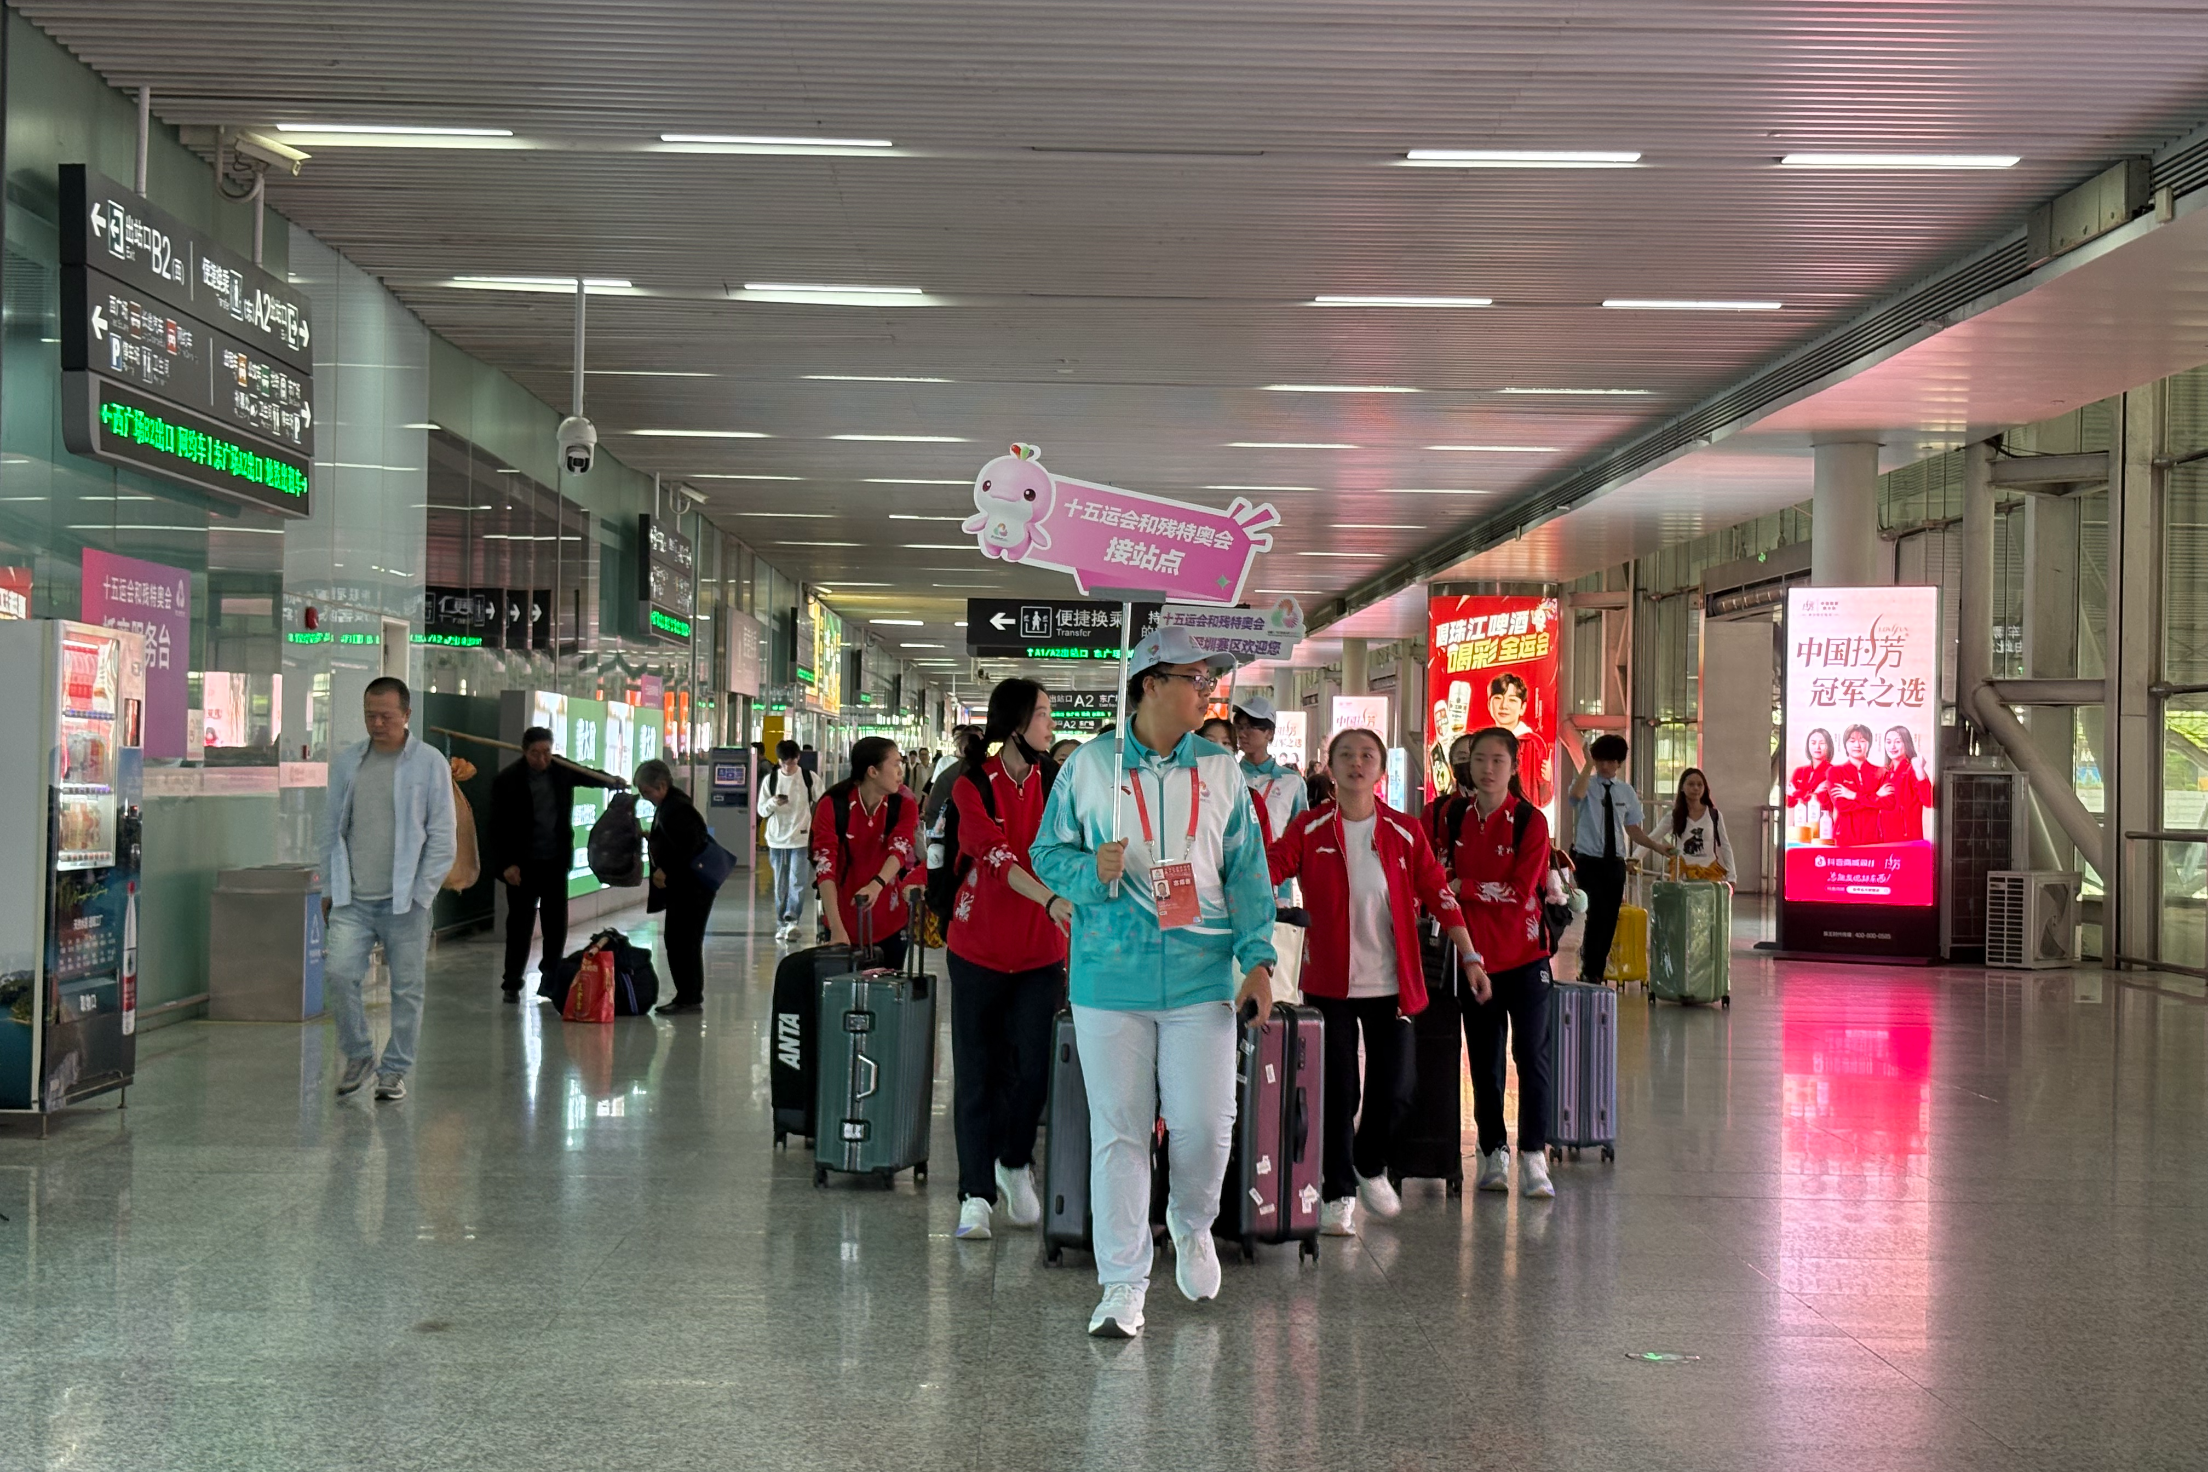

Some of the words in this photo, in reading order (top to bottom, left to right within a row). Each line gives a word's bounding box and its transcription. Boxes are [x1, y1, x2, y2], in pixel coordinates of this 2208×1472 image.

[152, 228, 171, 280] B2
[254, 288, 272, 333] A2
[1064, 498, 1235, 551] 十五运会和残特奥会
[1103, 536, 1186, 576] 接站点
[103, 574, 172, 610] 十五运会和残特奥会
[1055, 608, 1123, 628] 便捷换乘
[1056, 628, 1092, 637] Transfer
[1162, 611, 1266, 631] 十五运会和残特奥会
[1436, 610, 1530, 647] 喝珠江啤酒
[1447, 631, 1550, 674] 喝彩全运会
[1796, 614, 1906, 677] 中国拉芳
[1074, 694, 1095, 708] A2
[1809, 677, 1926, 708] 冠军之选
[1063, 720, 1076, 729] A2
[778, 1013, 801, 1070] ANTA
